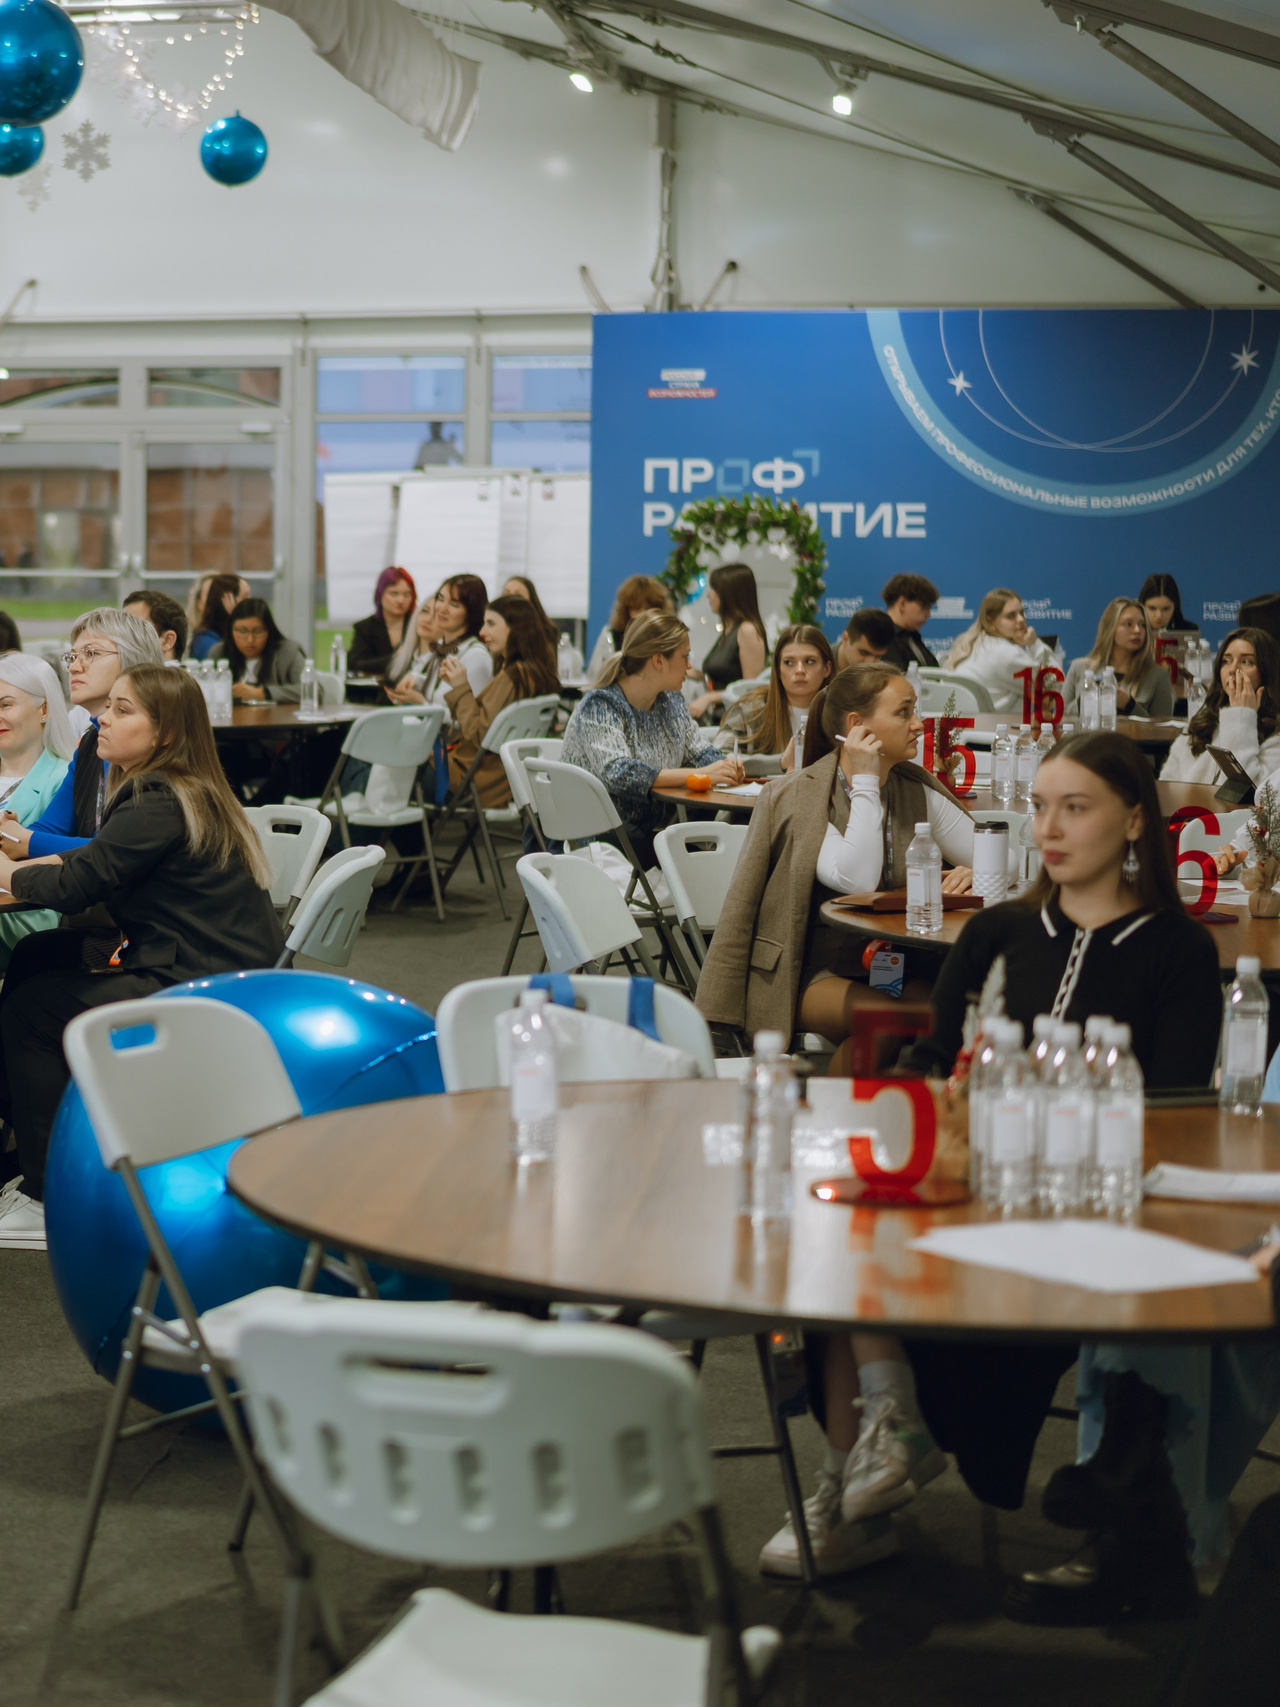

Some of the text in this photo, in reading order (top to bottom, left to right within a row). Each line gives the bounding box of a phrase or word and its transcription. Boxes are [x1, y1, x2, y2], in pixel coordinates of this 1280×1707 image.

[643, 457, 805, 494] ПРОФ
[930, 427, 1089, 509] ПРОФЕССИОНАЛЬНЫЕ
[1090, 468, 1216, 509] ВОЗМОЖНОСТИ
[1216, 445, 1247, 477] ДЛЯ
[643, 502, 927, 538] РАТИЕ
[1203, 611, 1238, 621] РАЗВИ
[1013, 666, 1066, 727] 16
[922, 717, 977, 799] 15
[1169, 806, 1220, 916] 6
[848, 1008, 937, 1186] 5
